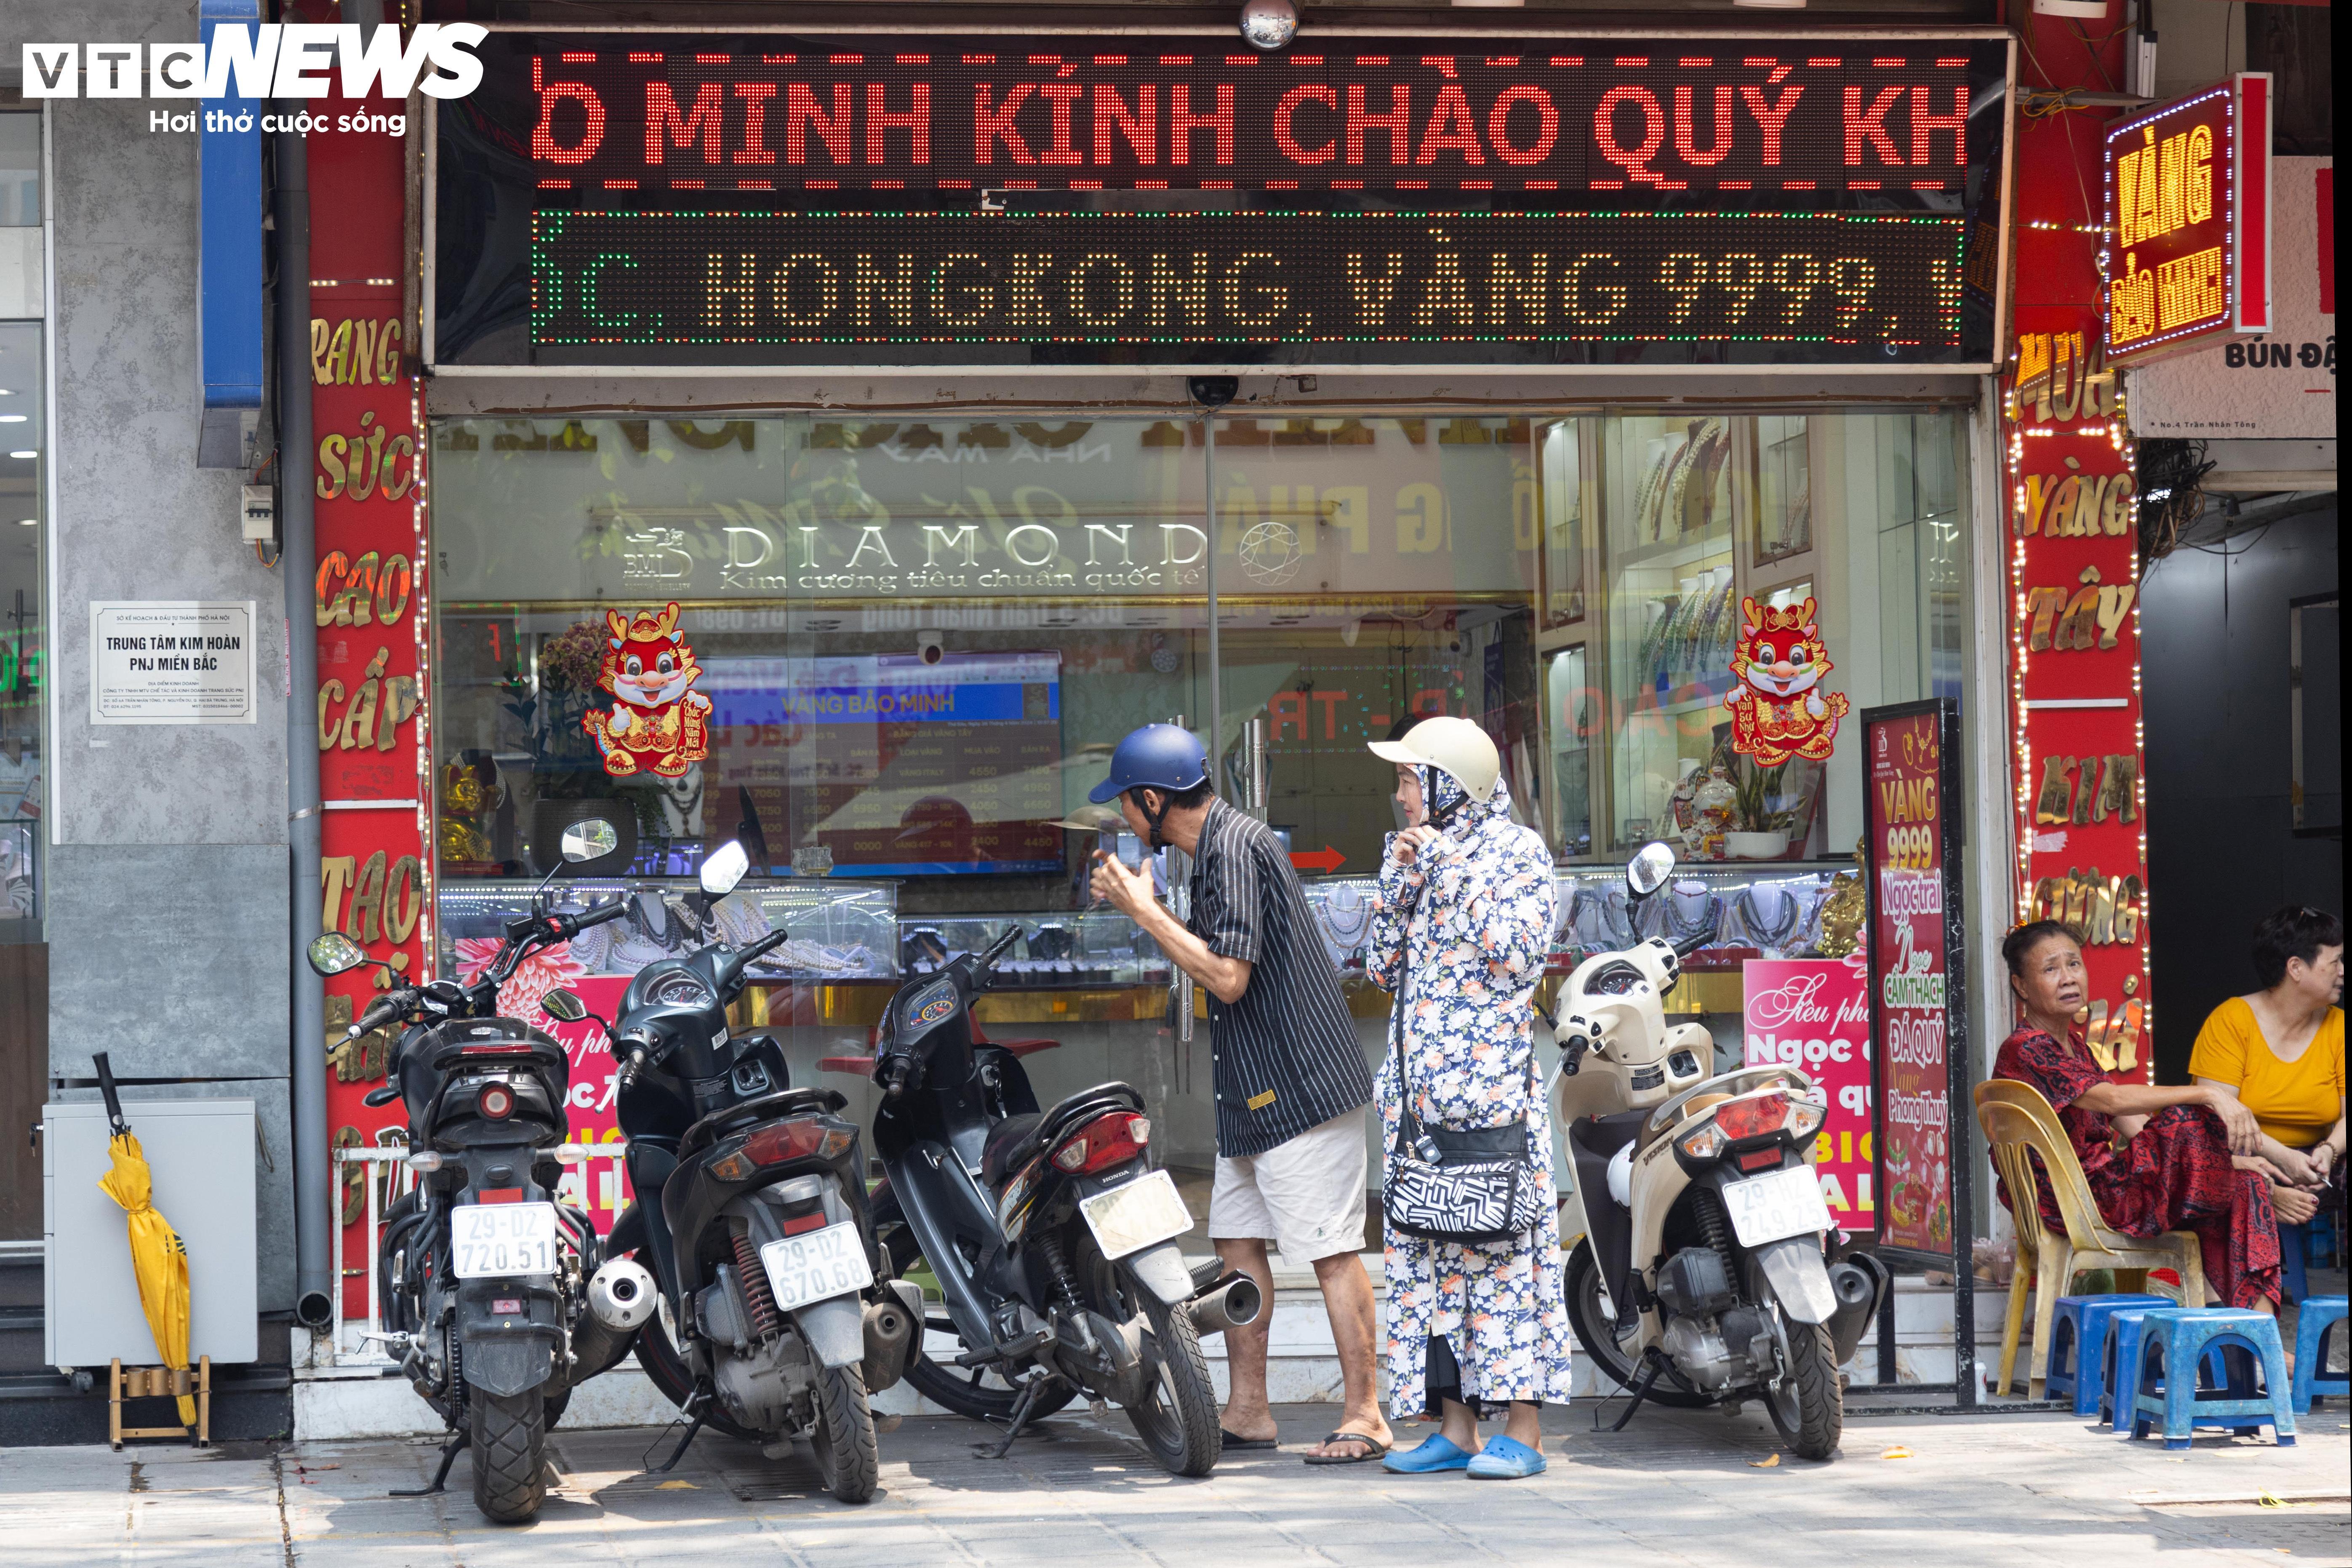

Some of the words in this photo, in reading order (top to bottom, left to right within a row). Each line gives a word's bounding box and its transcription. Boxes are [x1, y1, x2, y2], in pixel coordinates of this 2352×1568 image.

[533, 57, 605, 164] O
[645, 83, 930, 165] MINH
[975, 64, 1234, 165] KÍNH
[1272, 58, 1559, 165] CHÀO
[1594, 65, 1805, 181] QUÝ
[1843, 86, 1969, 166] KH
[2118, 125, 2212, 248] VÀNG
[701, 253, 1312, 335] HONGKONG,
[1346, 229, 1628, 327] VÀNG
[1653, 253, 1898, 338] 9999,
[2110, 252, 2155, 345] BẢO
[2226, 335, 2292, 368] BÚN
[2012, 332, 2117, 423] MUA
[317, 411, 413, 501] SỨC
[2024, 456, 2133, 537] VÀNG
[723, 525, 1208, 568] DIAMOND
[316, 551, 410, 627] CAO
[719, 571, 787, 589] Kim
[798, 573, 897, 594] cương
[907, 570, 968, 588] tiêu
[978, 565, 1076, 588] chuẩn
[1085, 565, 1161, 592] quốc
[1173, 565, 1205, 586] tế
[2026, 565, 2136, 651] TÂY
[107, 637, 146, 650] TRUNG
[150, 635, 175, 650] TÂM
[181, 637, 203, 650] KIM
[208, 634, 240, 650] HOÀN
[130, 658, 153, 670] PNJ
[158, 653, 189, 670] MIỀN
[194, 653, 217, 670] BẮC
[318, 646, 417, 752] CẤP
[684, 705, 700, 717] Chúc
[781, 689, 843, 714] VÀNG
[849, 689, 894, 713] BẢO
[900, 694, 955, 712] MINH
[1736, 701, 1753, 712] Vạn
[1739, 712, 1752, 723] Sự
[684, 717, 700, 729] Mừng
[684, 729, 699, 737] Năm
[685, 738, 699, 747] Mới
[1881, 769, 1936, 824] VÀNG
[2036, 754, 2136, 825] KIM
[1888, 825, 1933, 869] 9999
[1881, 869, 1917, 925] Ngọc
[1917, 867, 1942, 914] trai
[1747, 973, 1830, 1029] Siêu
[1748, 1034, 1853, 1072] Ngọc
[1889, 1011, 1913, 1063] ĐÁ
[1912, 1012, 1944, 1069] QUÝ
[1888, 1088, 1923, 1132] Phong
[1643, 1135, 1674, 1166] VISION
[1102, 1170, 1130, 1184] HONDA
[468, 1209, 538, 1240] 29-D2
[1741, 1199, 1823, 1241] 249.25
[461, 1240, 547, 1273] 720.51
[777, 1230, 848, 1272] 29-D2
[779, 1257, 865, 1304] 670.68
